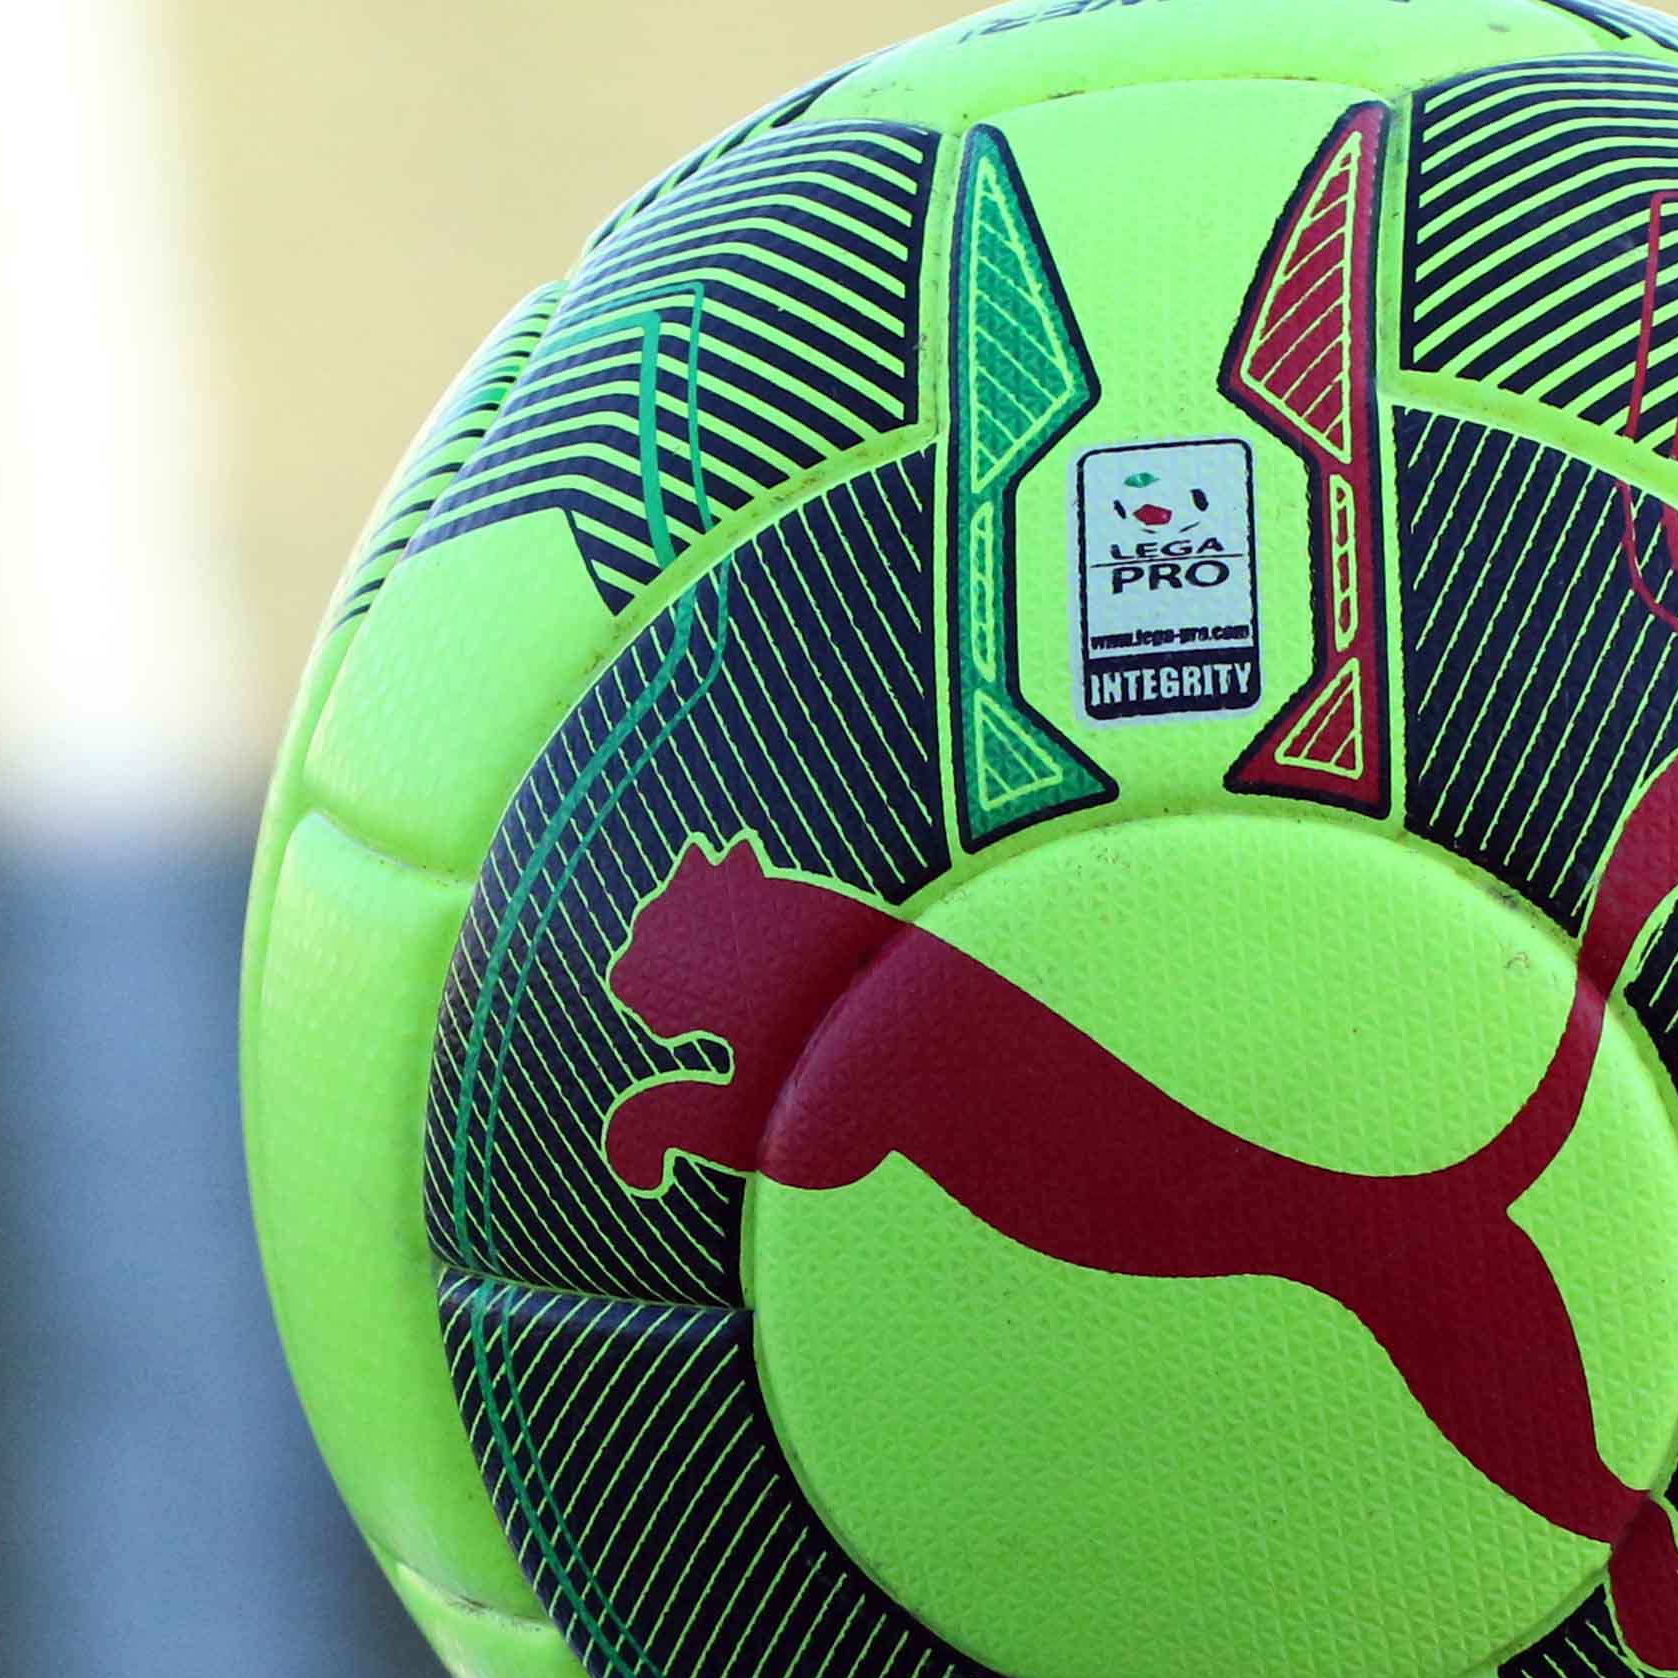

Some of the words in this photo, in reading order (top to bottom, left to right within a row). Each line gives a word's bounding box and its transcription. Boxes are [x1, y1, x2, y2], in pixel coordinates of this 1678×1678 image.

[1110, 537, 1225, 560] LEGA
[1111, 560, 1230, 594] PRO
[1089, 662, 1252, 707] INTEGRITY
